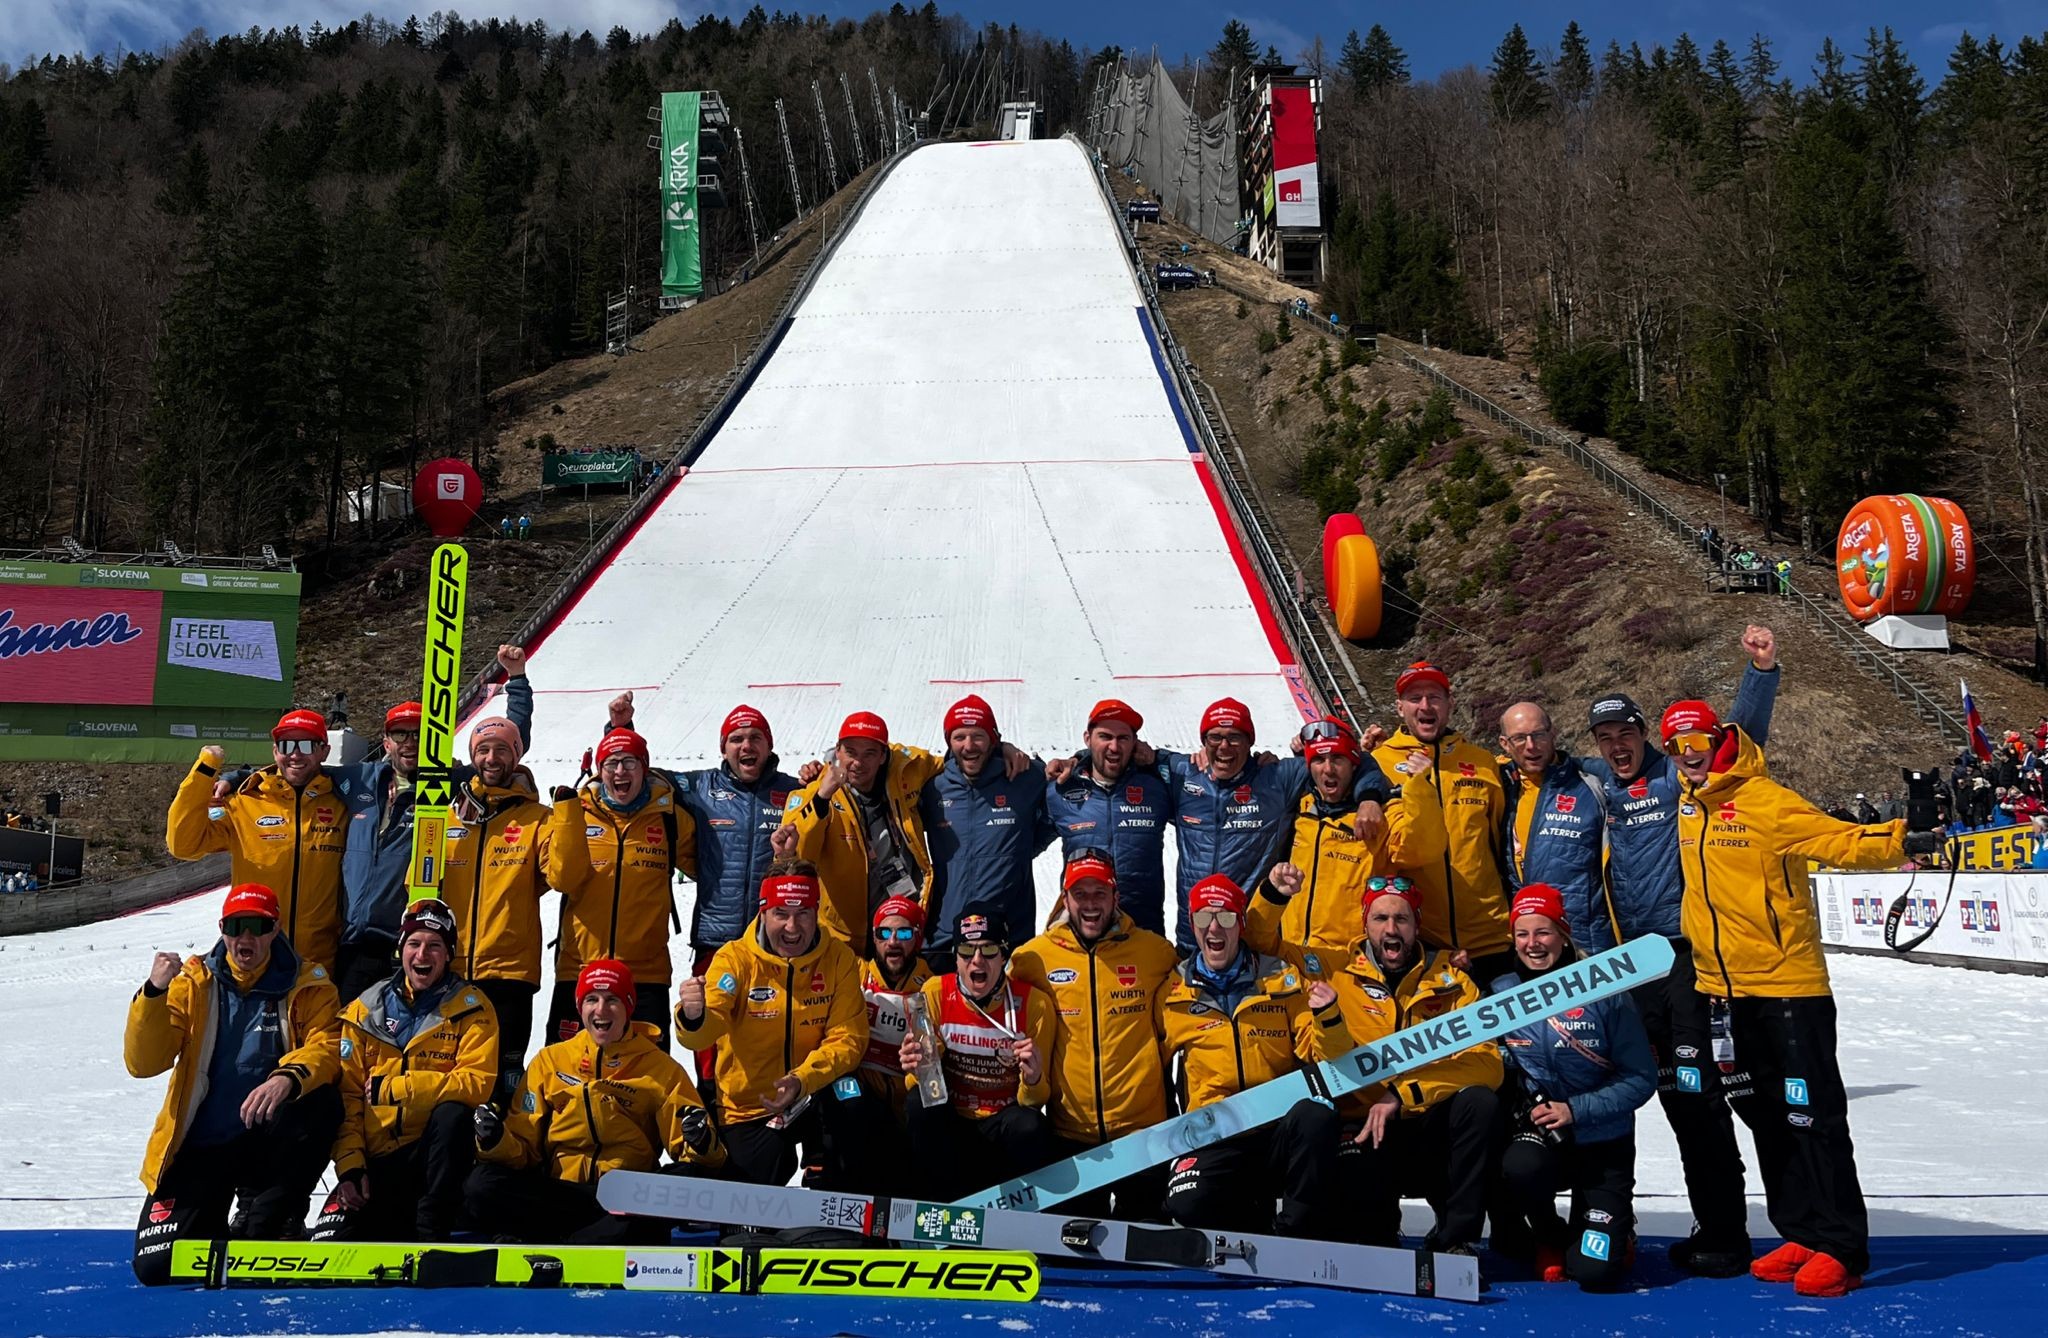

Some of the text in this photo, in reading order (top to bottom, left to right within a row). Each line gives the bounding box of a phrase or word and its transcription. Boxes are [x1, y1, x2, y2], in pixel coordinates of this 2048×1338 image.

[670, 141, 689, 195] KRKA
[568, 461, 616, 473] europlakat
[1900, 513, 1921, 561] ARGETA
[1950, 522, 1966, 572] ARGETA
[97, 568, 150, 579] SLOVENIA
[174, 623, 230, 640] I FEEL
[173, 641, 264, 660] SLOVENIA
[426, 548, 462, 767] FISCHER
[84, 722, 138, 732] SLOVENIA
[1127, 818, 1155, 828] TERREX
[1233, 820, 1263, 829] TERREX
[1633, 811, 1666, 824] TERREX
[1549, 827, 1582, 839] TERREX
[1717, 838, 1750, 848] TERREX
[1886, 916, 1897, 946] SONY
[1118, 1003, 1147, 1015] TERREX
[1354, 951, 1638, 1078] DANKE STEPHAN
[1256, 1028, 1288, 1038] TERREX
[428, 1050, 456, 1061] TERRE
[961, 1056, 975, 1065] SKI
[1680, 1069, 1696, 1089] TQ
[929, 1080, 940, 1099] 3
[1786, 1082, 1804, 1102] TQ
[979, 1185, 1034, 1211] ENT
[819, 1198, 829, 1222] VAN
[827, 1196, 838, 1226] DEER
[955, 1217, 976, 1227] HOLZ
[950, 1225, 981, 1235] RETTET
[951, 1233, 977, 1242] KLIMA
[1586, 1233, 1605, 1256] TQ
[144, 1241, 172, 1255] TERREX
[641, 1265, 683, 1275] Betten.de
[758, 1258, 1032, 1293] FISCHER
